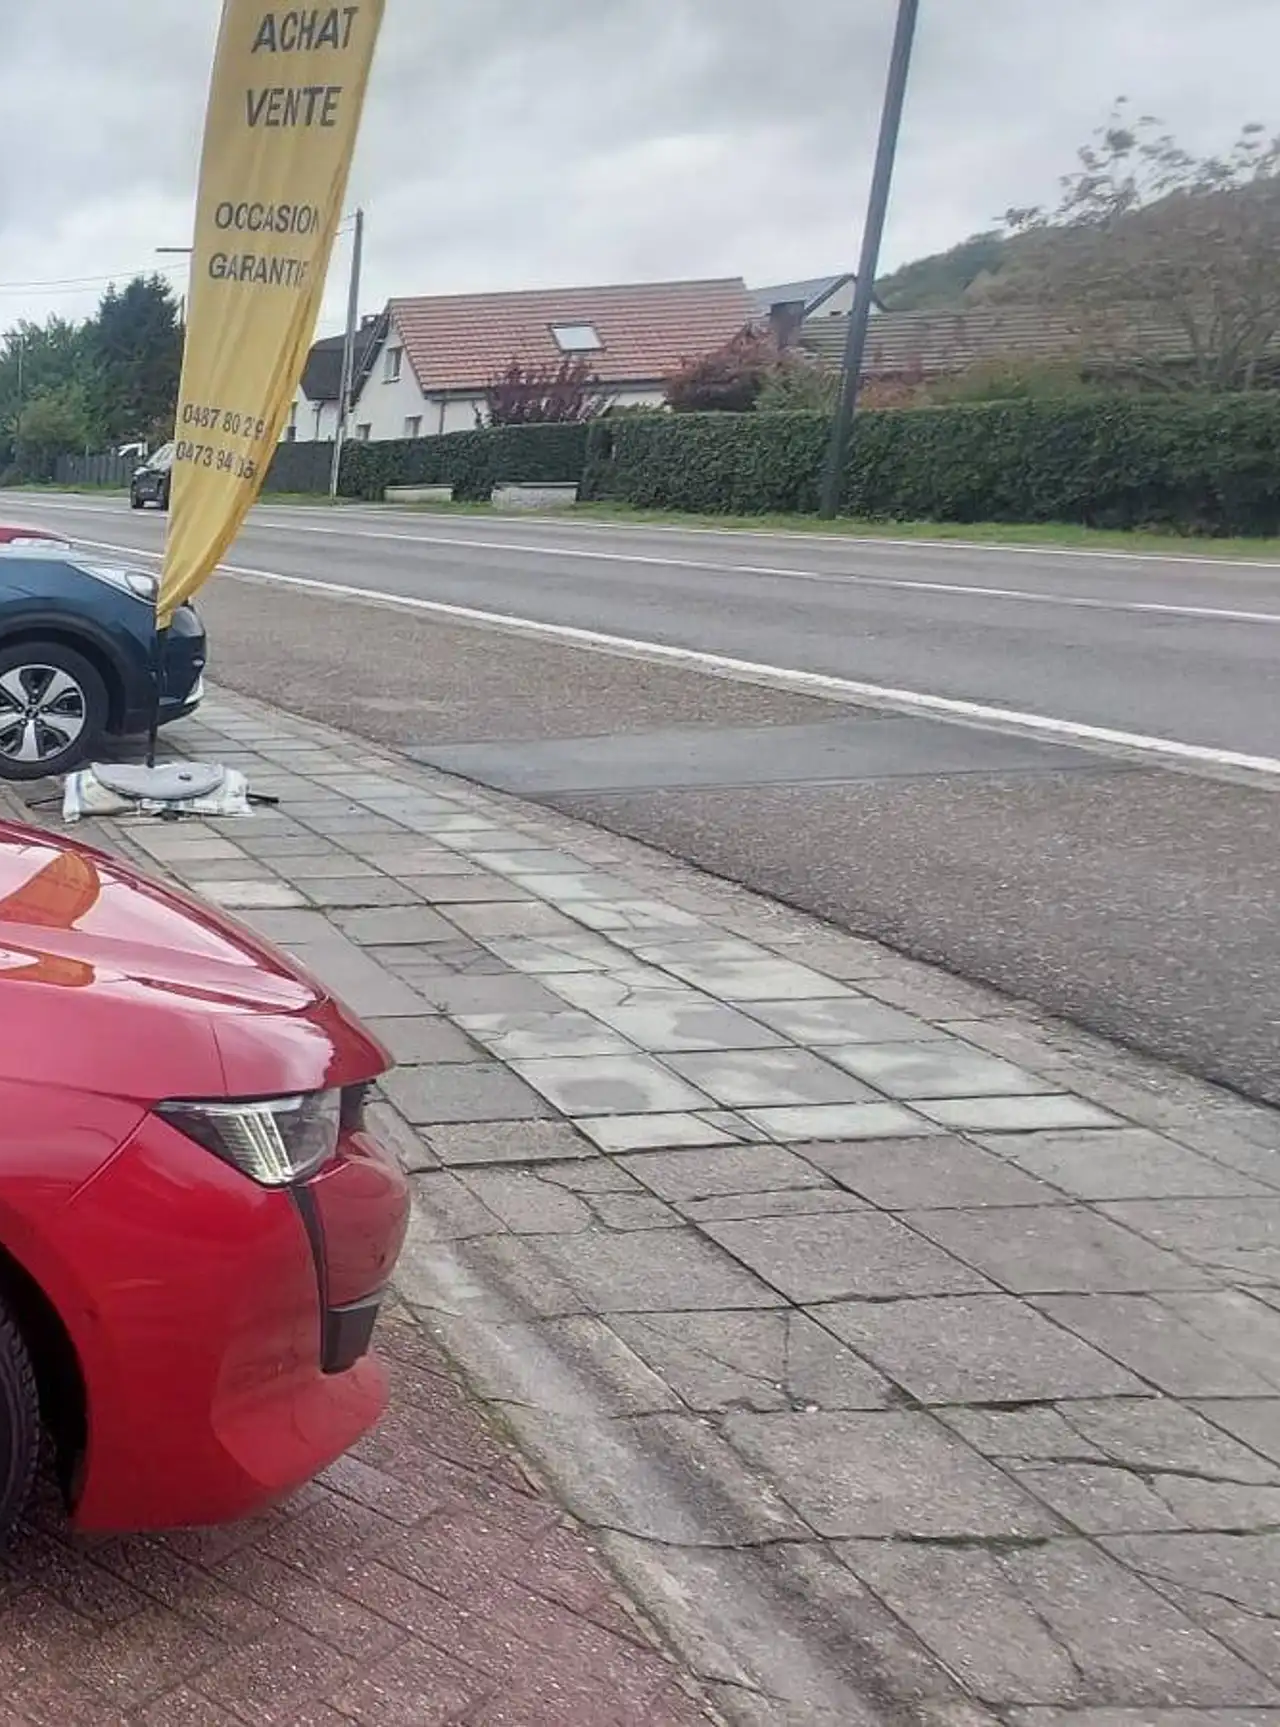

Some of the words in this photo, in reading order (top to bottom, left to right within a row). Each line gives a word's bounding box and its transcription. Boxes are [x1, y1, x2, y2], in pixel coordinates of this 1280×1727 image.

[250, 6, 359, 54] ACHAT
[246, 86, 343, 128] VENTE
[183, 404, 221, 429] 0487
[223, 411, 241, 435] 80
[176, 440, 214, 468] 0473
